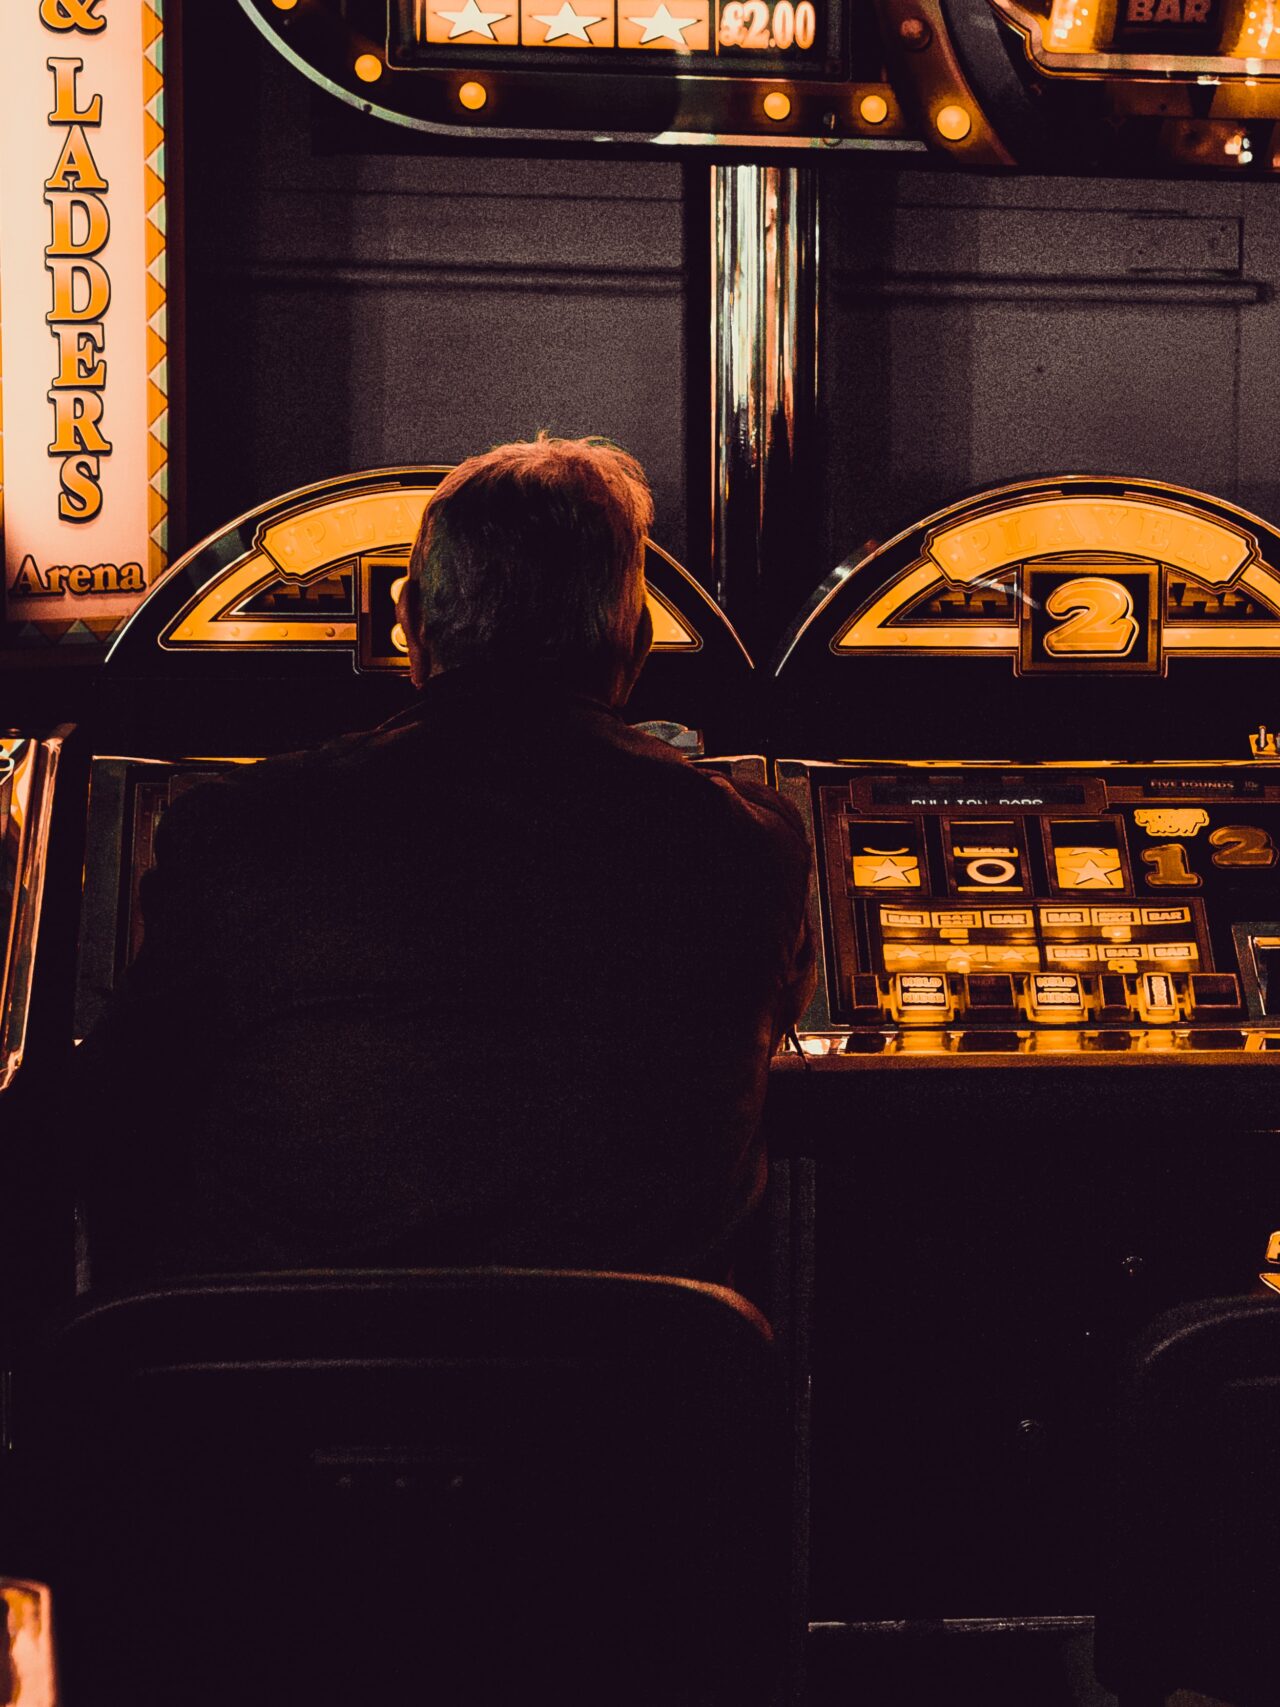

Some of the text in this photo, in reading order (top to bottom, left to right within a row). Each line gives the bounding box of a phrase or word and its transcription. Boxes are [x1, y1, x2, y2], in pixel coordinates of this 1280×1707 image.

[1126, 0, 1211, 24] BAR
[719, 0, 816, 49] £2.00
[43, 56, 113, 524] LADDERS
[959, 505, 1215, 570] PLAYER
[9, 553, 147, 598] Arena
[1044, 577, 1139, 657] 2
[1181, 780, 1234, 789] POUNDS
[1209, 825, 1279, 868] 2
[1141, 843, 1203, 888] 1
[887, 914, 922, 925] BAR
[991, 914, 1026, 924] BAR
[1047, 913, 1082, 923] BAR
[1148, 911, 1182, 921] BAR
[1105, 948, 1140, 957] BAR
[1154, 947, 1190, 957] BAR
